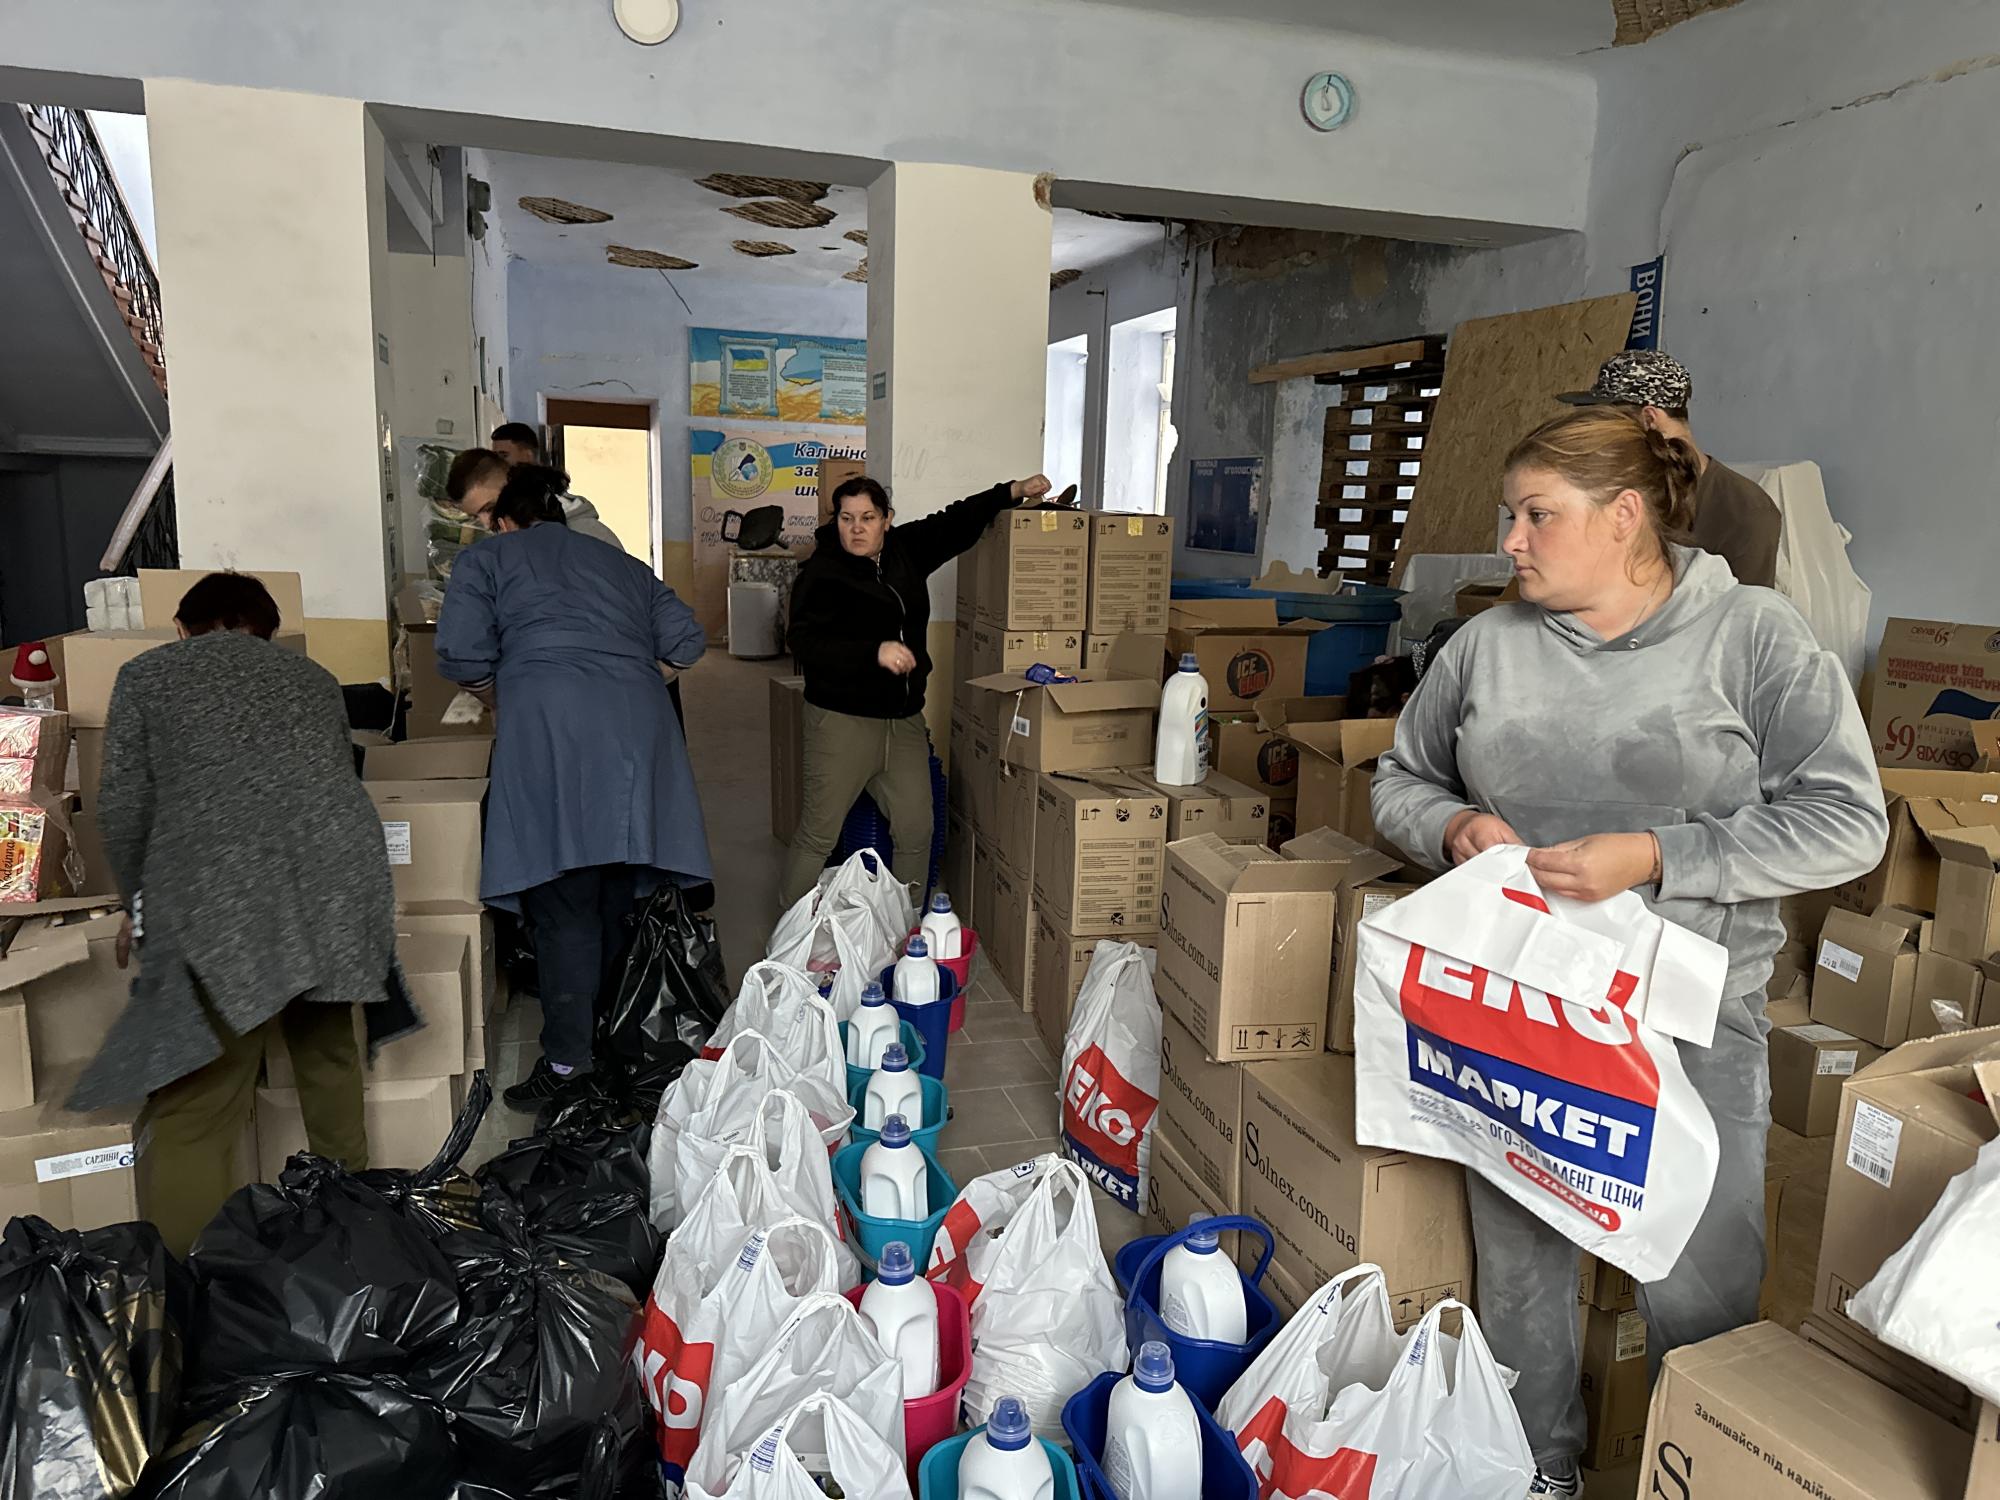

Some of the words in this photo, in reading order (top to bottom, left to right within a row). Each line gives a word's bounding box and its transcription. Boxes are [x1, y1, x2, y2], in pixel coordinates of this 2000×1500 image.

[1632, 268, 1657, 340] ВОНИ
[1237, 657, 1257, 679] ICE
[1268, 743, 1288, 766] ICE
[1884, 716, 1915, 761] 65
[1917, 744, 1974, 770] ОБУХІВ
[1160, 892, 1219, 984] Solnex.com.ua
[1067, 1063, 1137, 1147] ЕКО
[1161, 1036, 1234, 1145] Solnex.com.ua
[1418, 1039, 1640, 1158] МАРКЕТ
[85, 1152, 119, 1166] САРДИНИ
[1245, 1121, 1357, 1256] Solnex.com.ua
[1601, 1180, 1644, 1212] ЦІНИ
[1694, 1403, 1760, 1457] Залишайся
[1763, 1451, 1784, 1475] під
